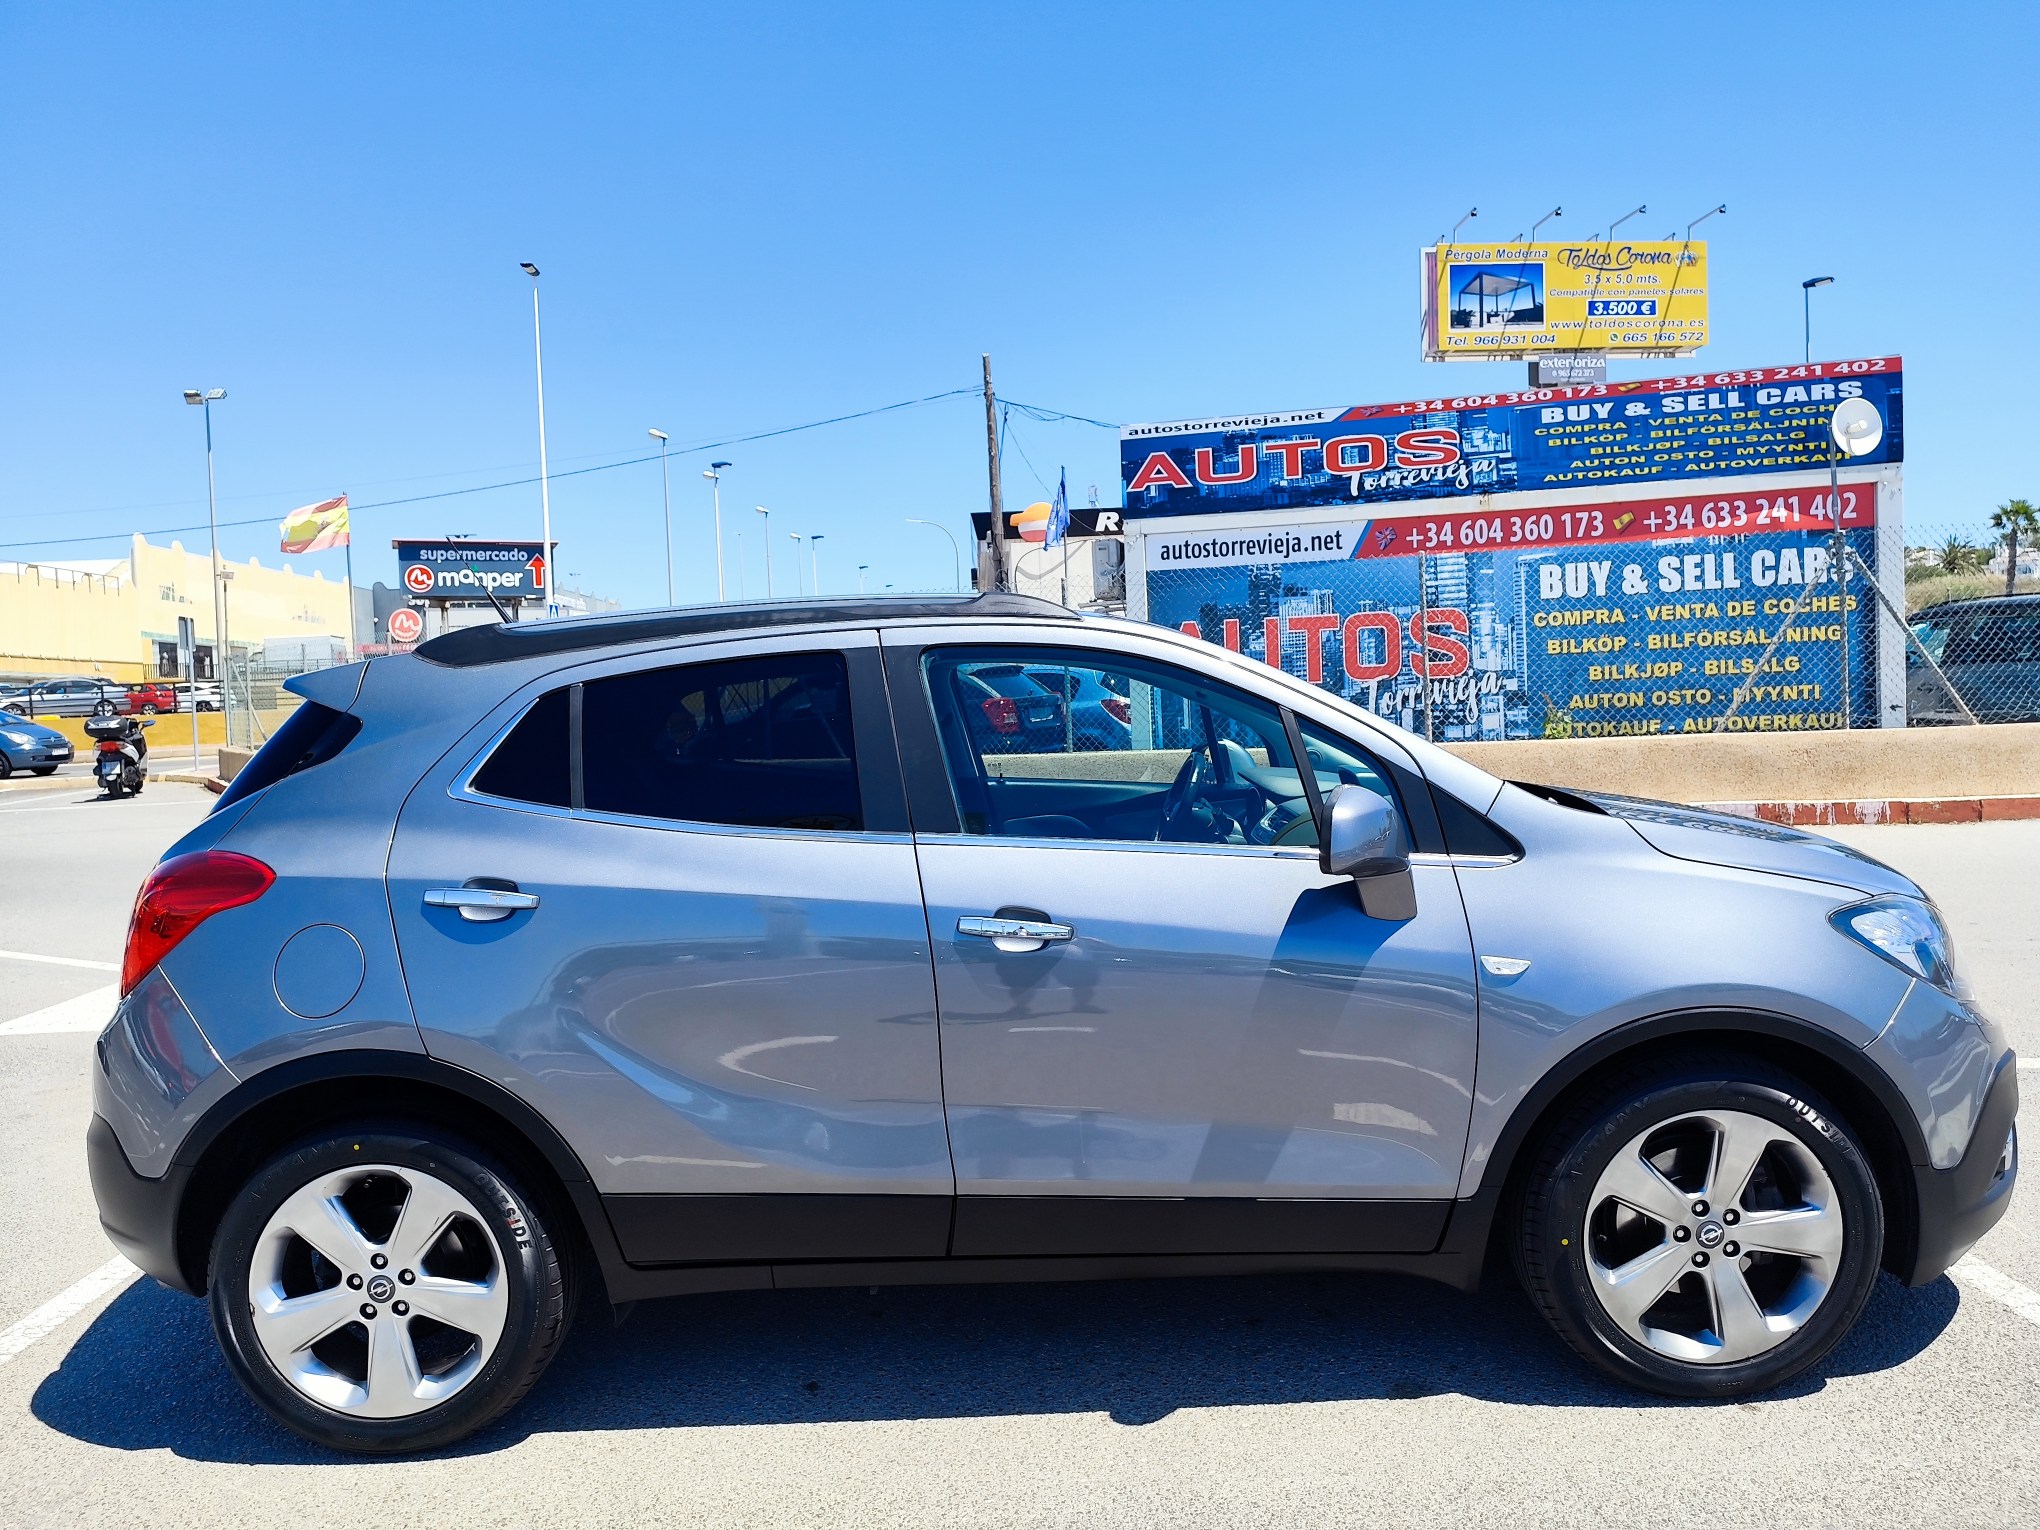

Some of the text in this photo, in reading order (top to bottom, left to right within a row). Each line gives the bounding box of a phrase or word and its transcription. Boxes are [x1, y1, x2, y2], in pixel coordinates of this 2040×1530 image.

[1445, 248, 1548, 261] Pérgola Moderna
[1557, 246, 1672, 270] Toldos Corona
[1549, 288, 1605, 297] Compatible
[1628, 288, 1666, 297] paneles
[1669, 287, 1704, 296] solares
[1636, 275, 1661, 284] mts.
[1593, 302, 1652, 315] 3.500 €
[1550, 318, 1704, 329] www.toldoscorona.es
[1622, 331, 1704, 342] 665 166 572
[1446, 334, 1556, 346] Tel. 966 931 004
[1540, 356, 1606, 368] exterioriza
[1651, 359, 1886, 391] +34 633 241 402
[1393, 385, 1608, 414] +34 604 360 173
[1541, 380, 1863, 424] BUY & SELL CARS
[1128, 411, 1325, 436] autostorrevieja.net
[1534, 420, 1626, 437] COMPRA
[1648, 412, 1723, 427] VENTA
[1731, 409, 1761, 420] DE
[1777, 403, 1839, 416] COCH
[1548, 430, 1628, 447] BILKÖP
[1650, 415, 1830, 440] BILFÖRSÄLJNIN
[1570, 454, 1645, 469] AUTON
[1654, 449, 1714, 462] OSTO
[1736, 441, 1827, 457] MYYNTI
[1590, 439, 1686, 456] BILKJØP
[1708, 430, 1806, 446] BILSALG
[1126, 428, 1462, 493] AUTOS
[1342, 457, 1496, 496] Torrevieja
[1543, 466, 1663, 483] AUTOKAUF
[1643, 491, 1857, 533] +34 633 241 402
[1405, 511, 1604, 549] +34 604 360 173
[420, 548, 528, 564] supermercado
[1160, 530, 1343, 561] autostorrevieja.net
[437, 569, 524, 592] manper
[1540, 545, 1854, 599] BUY & SELL CARS
[1533, 608, 1626, 628] COMPRA
[1646, 602, 1723, 622] VENTA
[1727, 600, 1757, 617] DE
[1179, 607, 1469, 685] UTOS
[1547, 630, 1628, 655] BILKÖP
[1647, 624, 1842, 651] BILFÖRSÄLNING
[1589, 660, 1684, 682] BILKJØP
[1570, 691, 1645, 710] AUTON
[1652, 688, 1712, 707] OSTO
